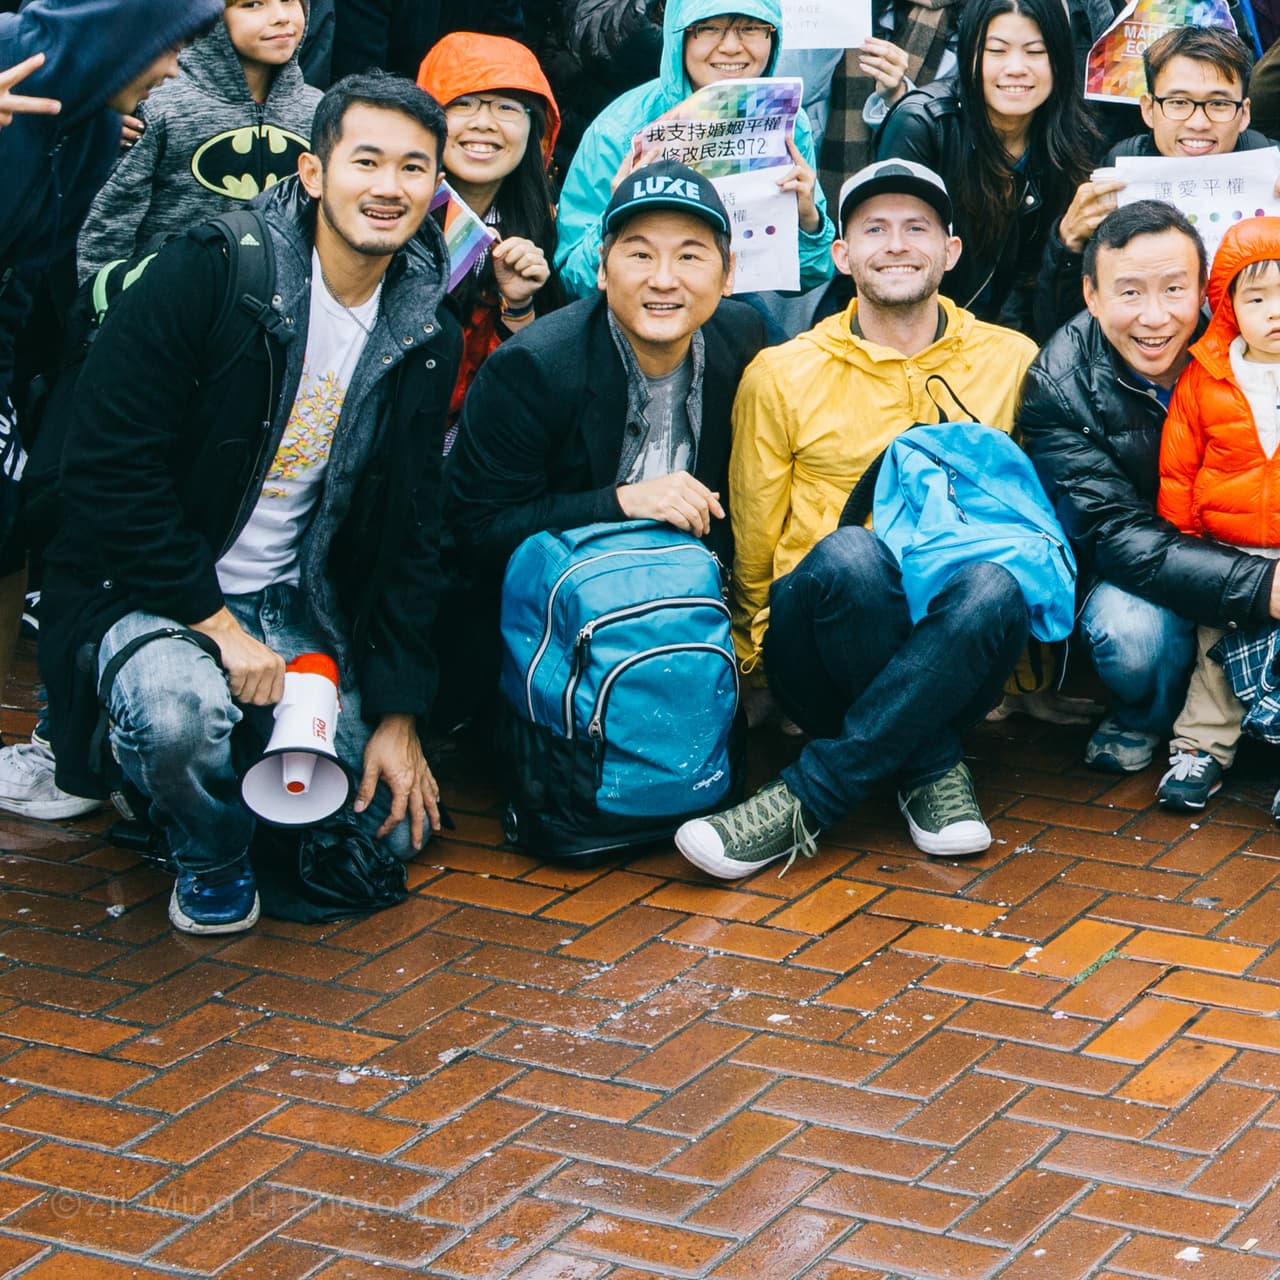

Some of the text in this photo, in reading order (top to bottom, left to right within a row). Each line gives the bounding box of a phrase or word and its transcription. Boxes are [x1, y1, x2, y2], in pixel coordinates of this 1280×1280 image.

[646, 116, 783, 143] 我支持婚姻平權
[662, 137, 767, 163] 修改民法972
[632, 176, 701, 201] LUXE
